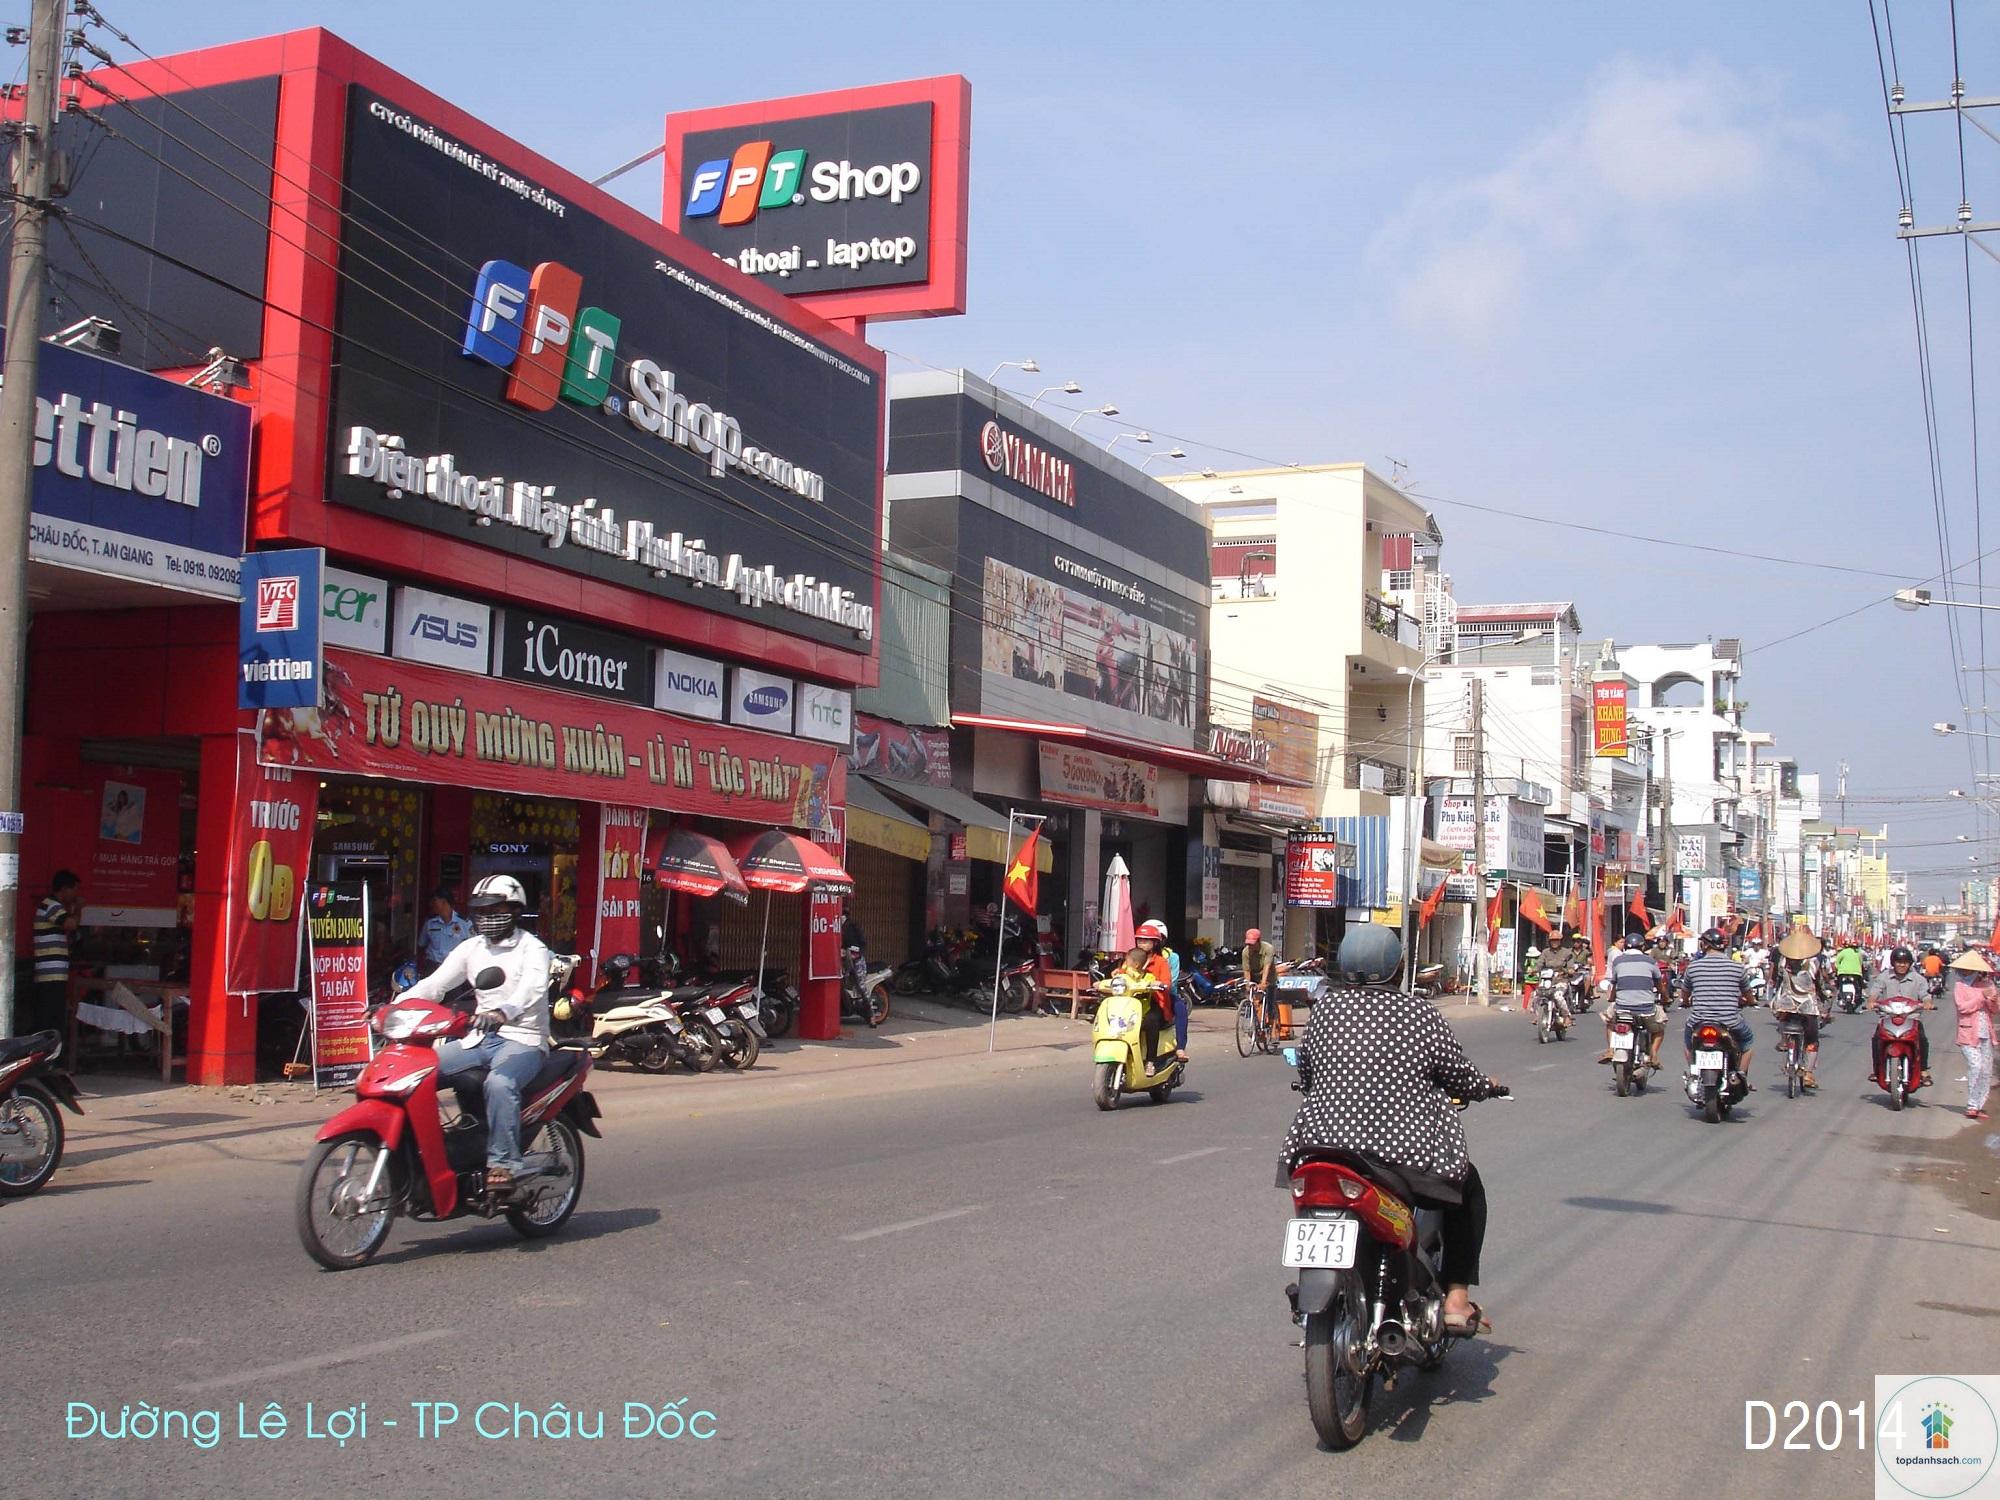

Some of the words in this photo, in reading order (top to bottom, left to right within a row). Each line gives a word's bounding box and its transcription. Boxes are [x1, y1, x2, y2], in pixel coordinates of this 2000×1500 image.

[809, 159, 922, 205] Shop
[738, 245, 802, 278] thoại
[826, 235, 917, 273] laptop
[1000, 428, 1076, 508] YAMAHA
[347, 425, 425, 500] Điện
[426, 453, 505, 528] thoại
[512, 480, 571, 549] Máy
[723, 553, 786, 609] Apple
[102, 540, 119, 560] AN
[119, 544, 154, 567] GIANG
[260, 580, 297, 602] VTEC
[409, 612, 479, 650] ASUS
[522, 619, 629, 692] iCorner
[243, 657, 314, 684] viettien
[667, 670, 718, 699] NOKIA
[748, 691, 786, 710] SAMSUNG
[1596, 701, 1625, 721] KHÁNH
[361, 685, 403, 748] TỨ
[410, 697, 467, 758] QUÝ
[474, 705, 557, 771] MỪNG
[561, 721, 626, 779] XUÂN
[646, 732, 668, 786] LÌ
[671, 738, 693, 790] XÌ
[249, 798, 300, 832] TRƯỚC
[1441, 811, 1456, 825] Phụ
[1457, 810, 1475, 825] Kiện
[1443, 799, 1462, 810] Shop
[332, 841, 376, 852] SAMSUNG
[489, 844, 529, 853] SONY
[601, 895, 623, 918] SẢN
[310, 911, 337, 940] TUYỂN
[337, 917, 364, 945] DỤNG
[320, 980, 334, 1000] TẠI
[1297, 1223, 1346, 1243] 67-Z1
[1294, 1244, 1344, 1263] 3413
